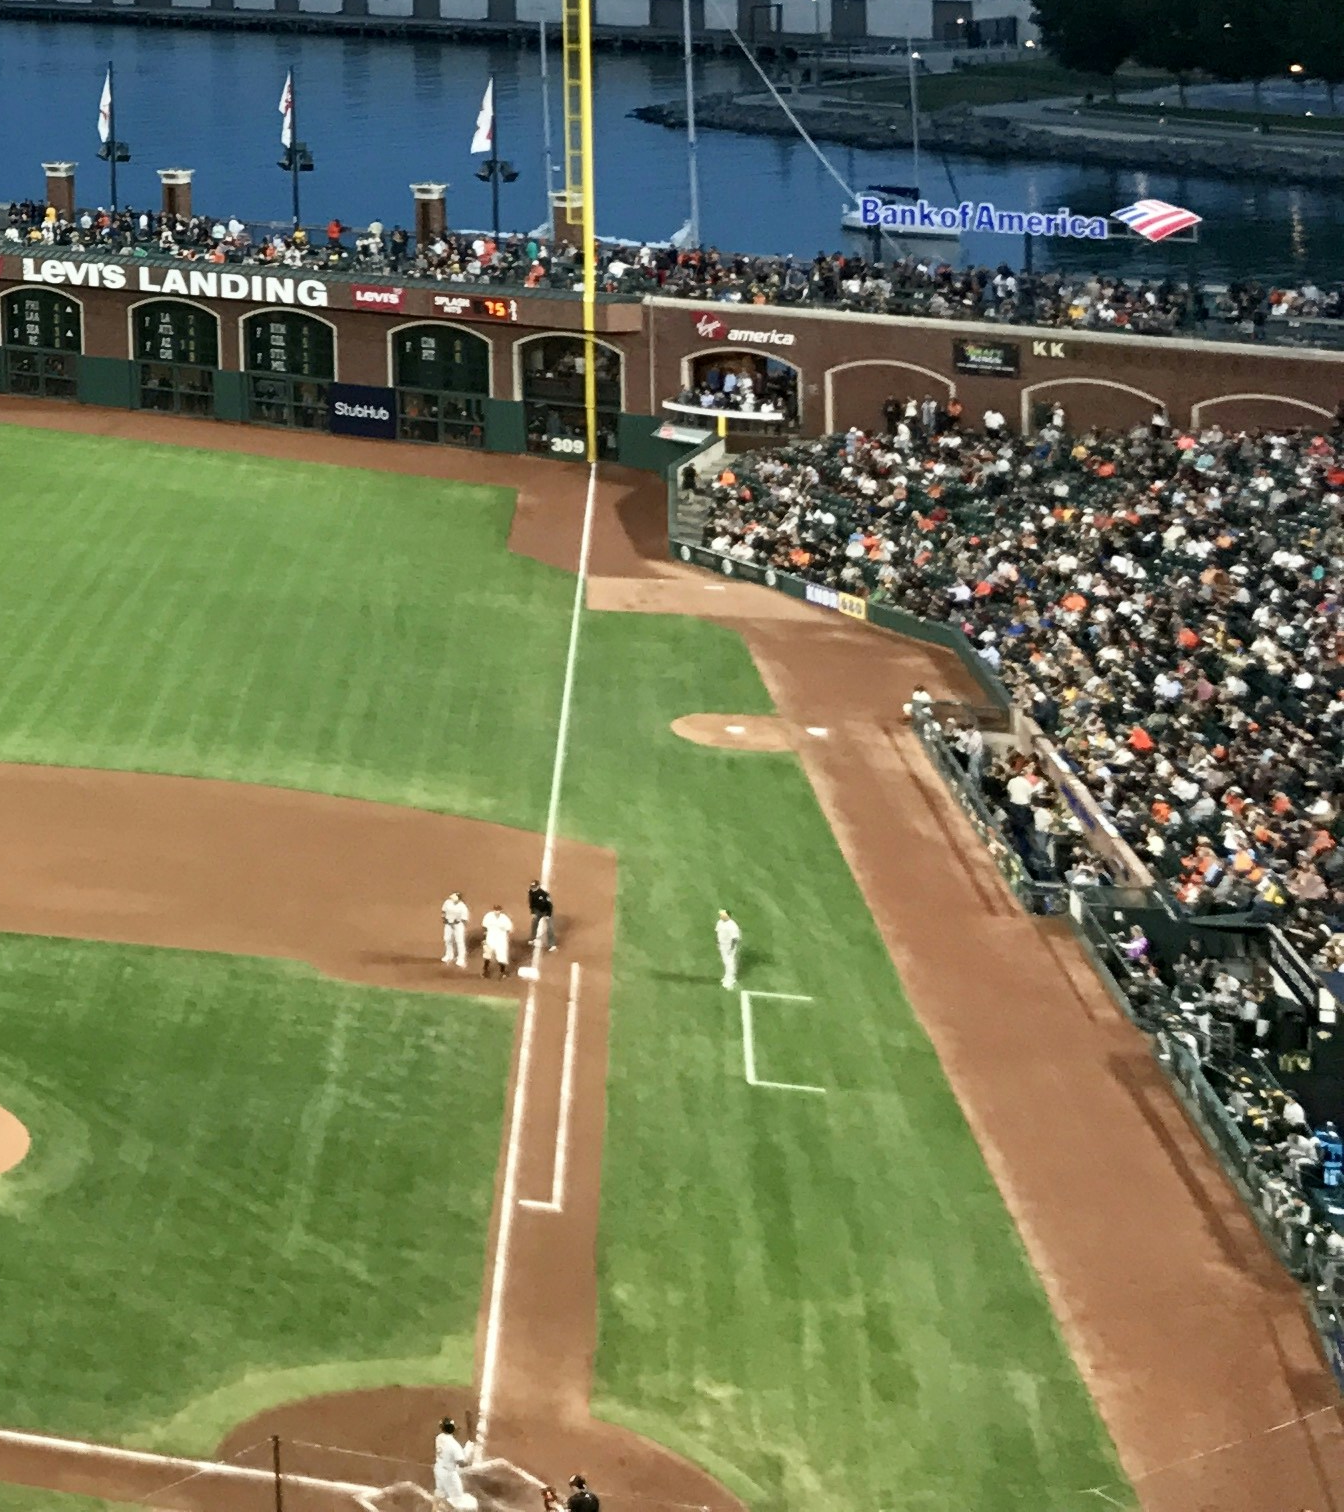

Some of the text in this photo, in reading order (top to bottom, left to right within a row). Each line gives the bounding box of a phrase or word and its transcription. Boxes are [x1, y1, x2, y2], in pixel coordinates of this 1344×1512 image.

[861, 196, 1108, 239] Bank of America
[138, 265, 329, 307] LANDING
[434, 295, 471, 308] SPLASH
[484, 301, 506, 317] 75
[727, 328, 795, 346] america
[1032, 340, 1066, 358] K K
[334, 401, 390, 422] StubHub
[550, 437, 585, 454] 309
